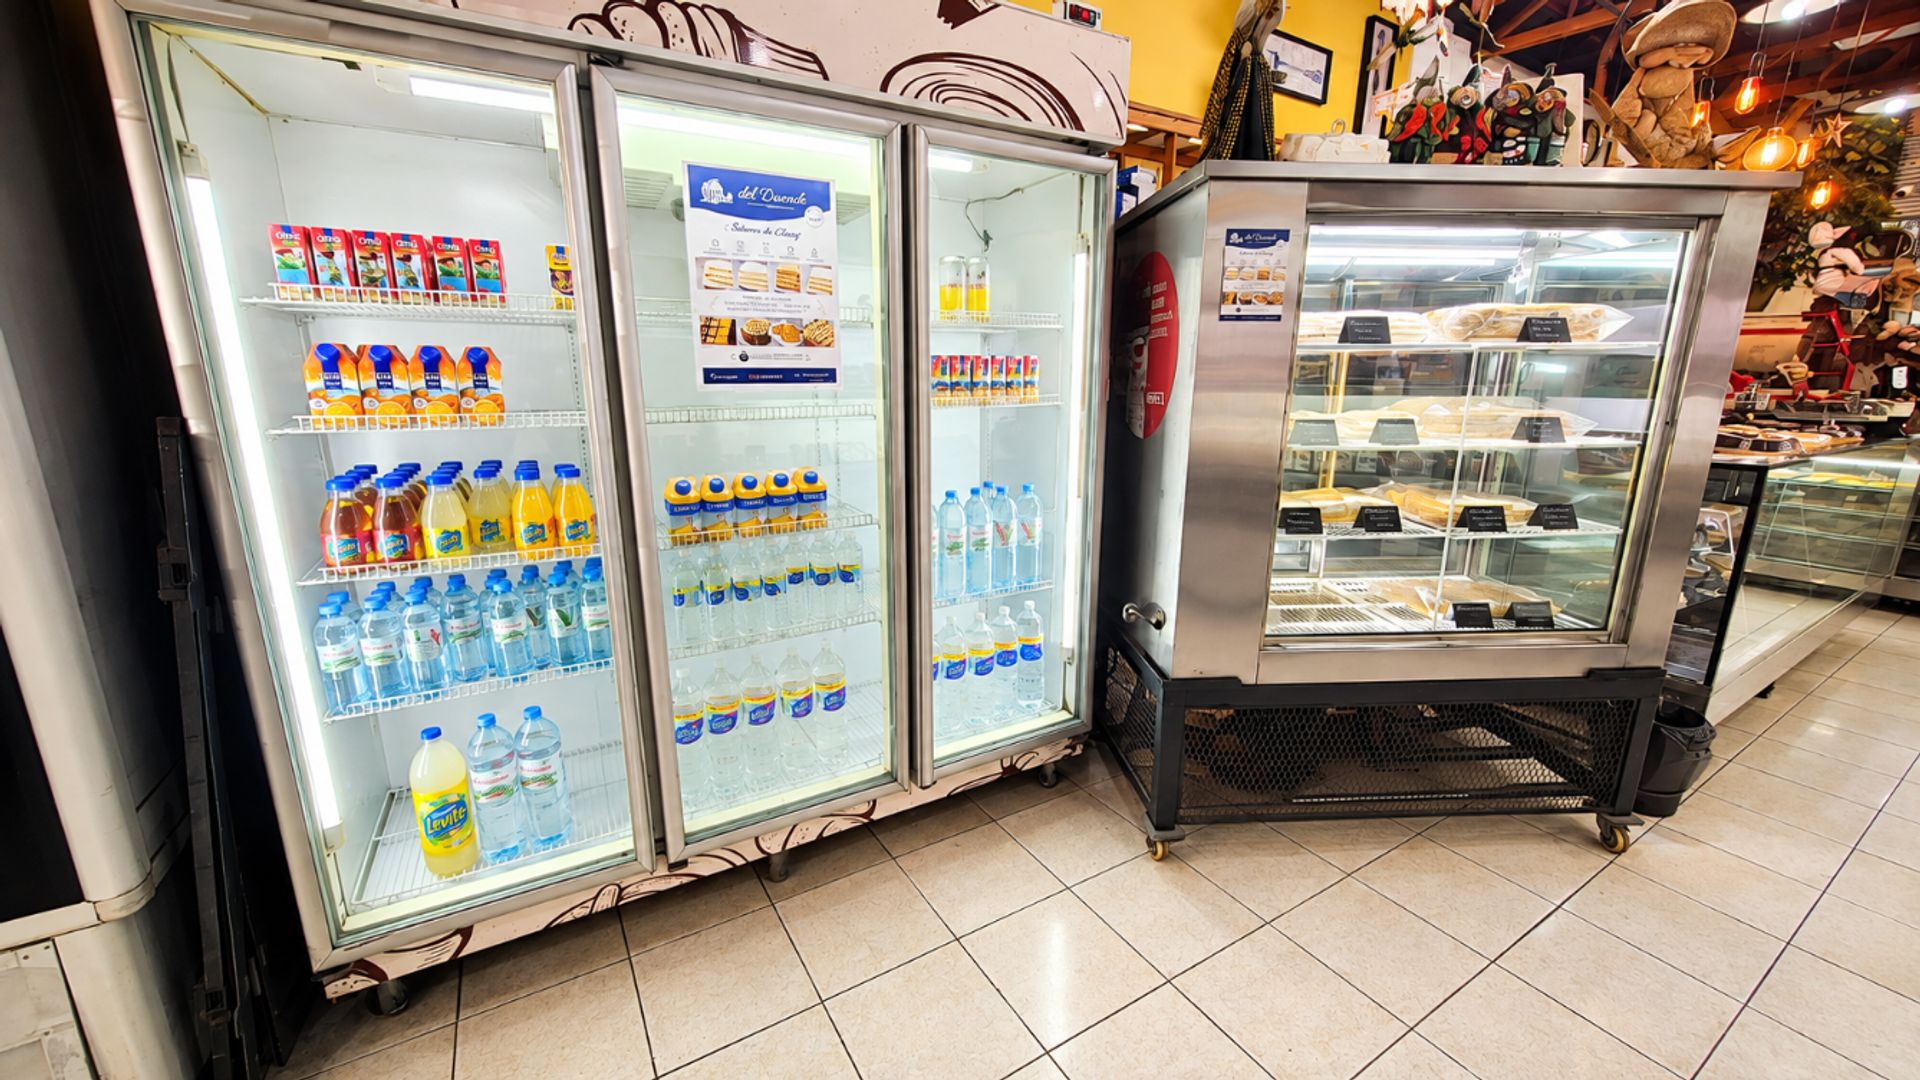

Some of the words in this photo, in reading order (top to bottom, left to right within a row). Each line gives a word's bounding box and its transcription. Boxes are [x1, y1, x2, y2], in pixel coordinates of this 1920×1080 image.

[738, 185, 757, 200] del
[760, 187, 807, 205] Duende
[427, 806, 466, 834] Levite
